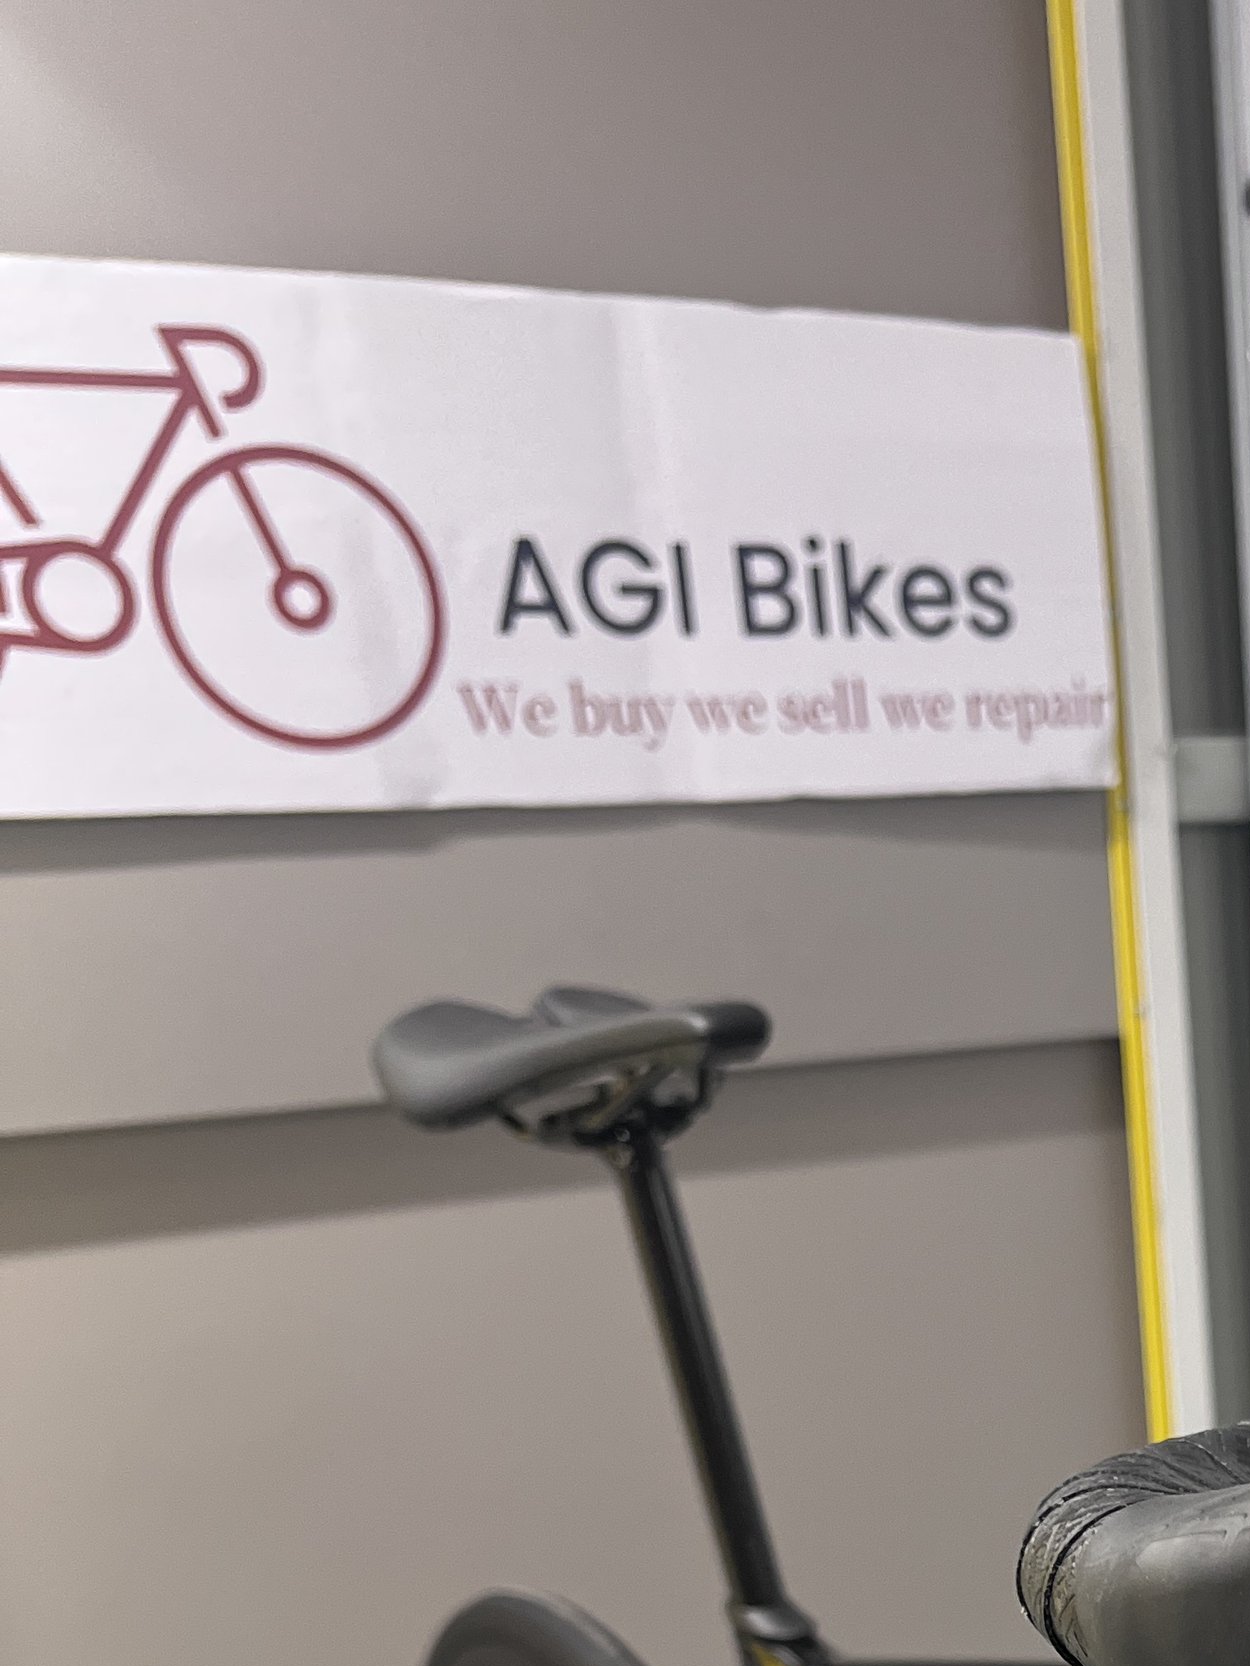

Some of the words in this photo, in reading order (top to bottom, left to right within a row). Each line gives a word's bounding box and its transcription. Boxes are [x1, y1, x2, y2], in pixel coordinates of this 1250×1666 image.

[498, 535, 697, 638] AGI
[736, 535, 1014, 640] Bikes
[460, 682, 555, 736] We
[569, 680, 673, 749] buy
[687, 690, 765, 734] we
[777, 681, 870, 732] sell
[881, 687, 954, 731] we
